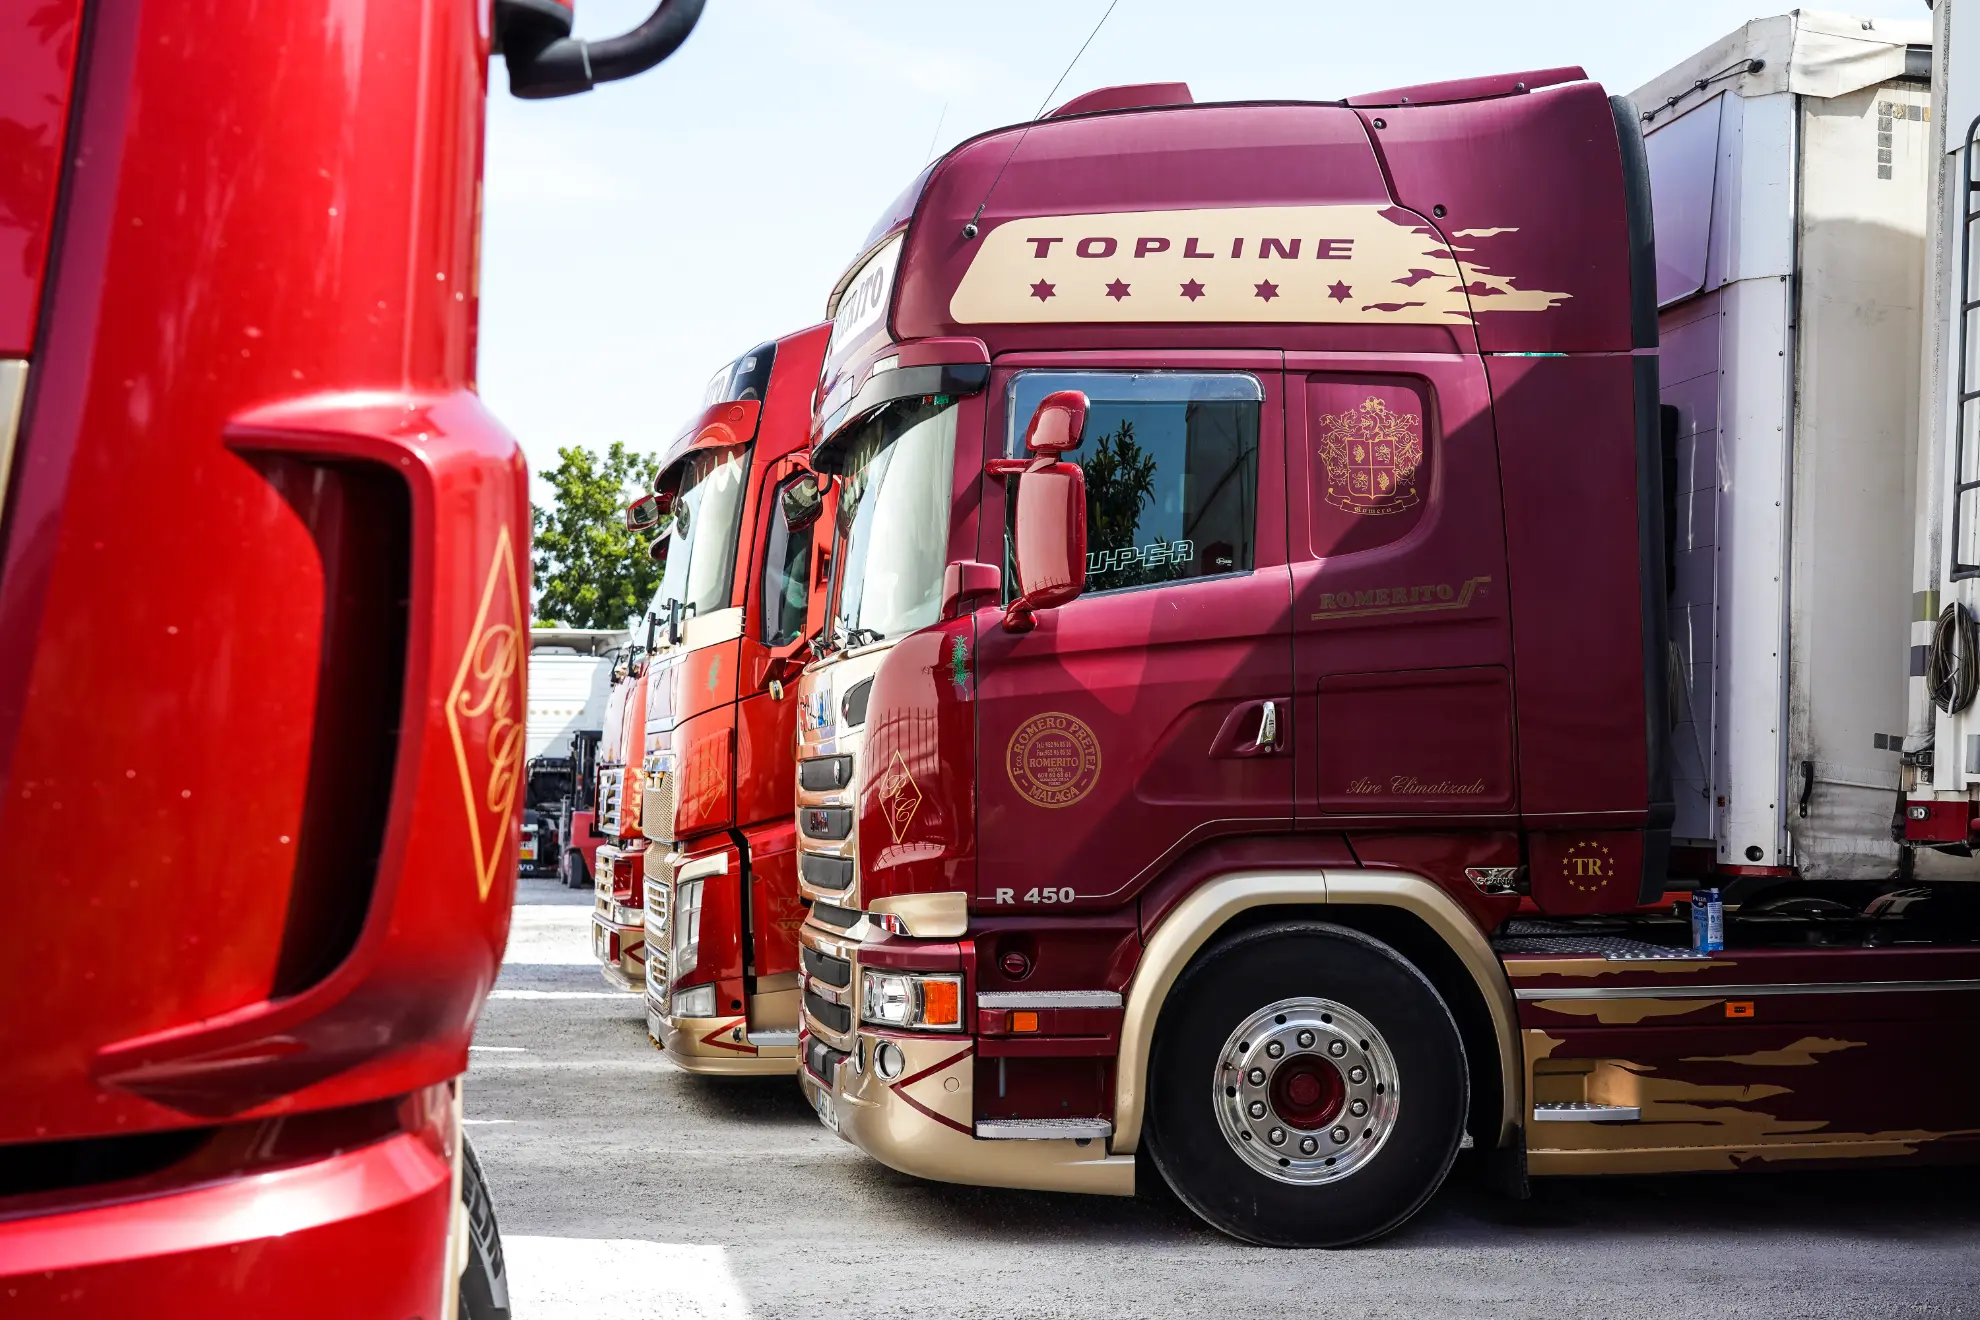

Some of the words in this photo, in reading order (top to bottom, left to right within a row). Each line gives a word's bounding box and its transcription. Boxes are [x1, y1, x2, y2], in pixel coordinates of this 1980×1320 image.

[1026, 237, 1355, 260] TOPLINE
[1085, 539, 1194, 575] UPER
[1319, 584, 1454, 610] ROMERITO
[1014, 717, 1067, 753] ROMERO
[1029, 757, 1079, 768] ROMERITO
[1029, 785, 1080, 803] MALAGA
[1346, 776, 1382, 794] Aire
[1390, 775, 1485, 794] Climatizado
[1572, 858, 1603, 876] TR
[996, 887, 1015, 904] R
[1023, 886, 1076, 904] 450
